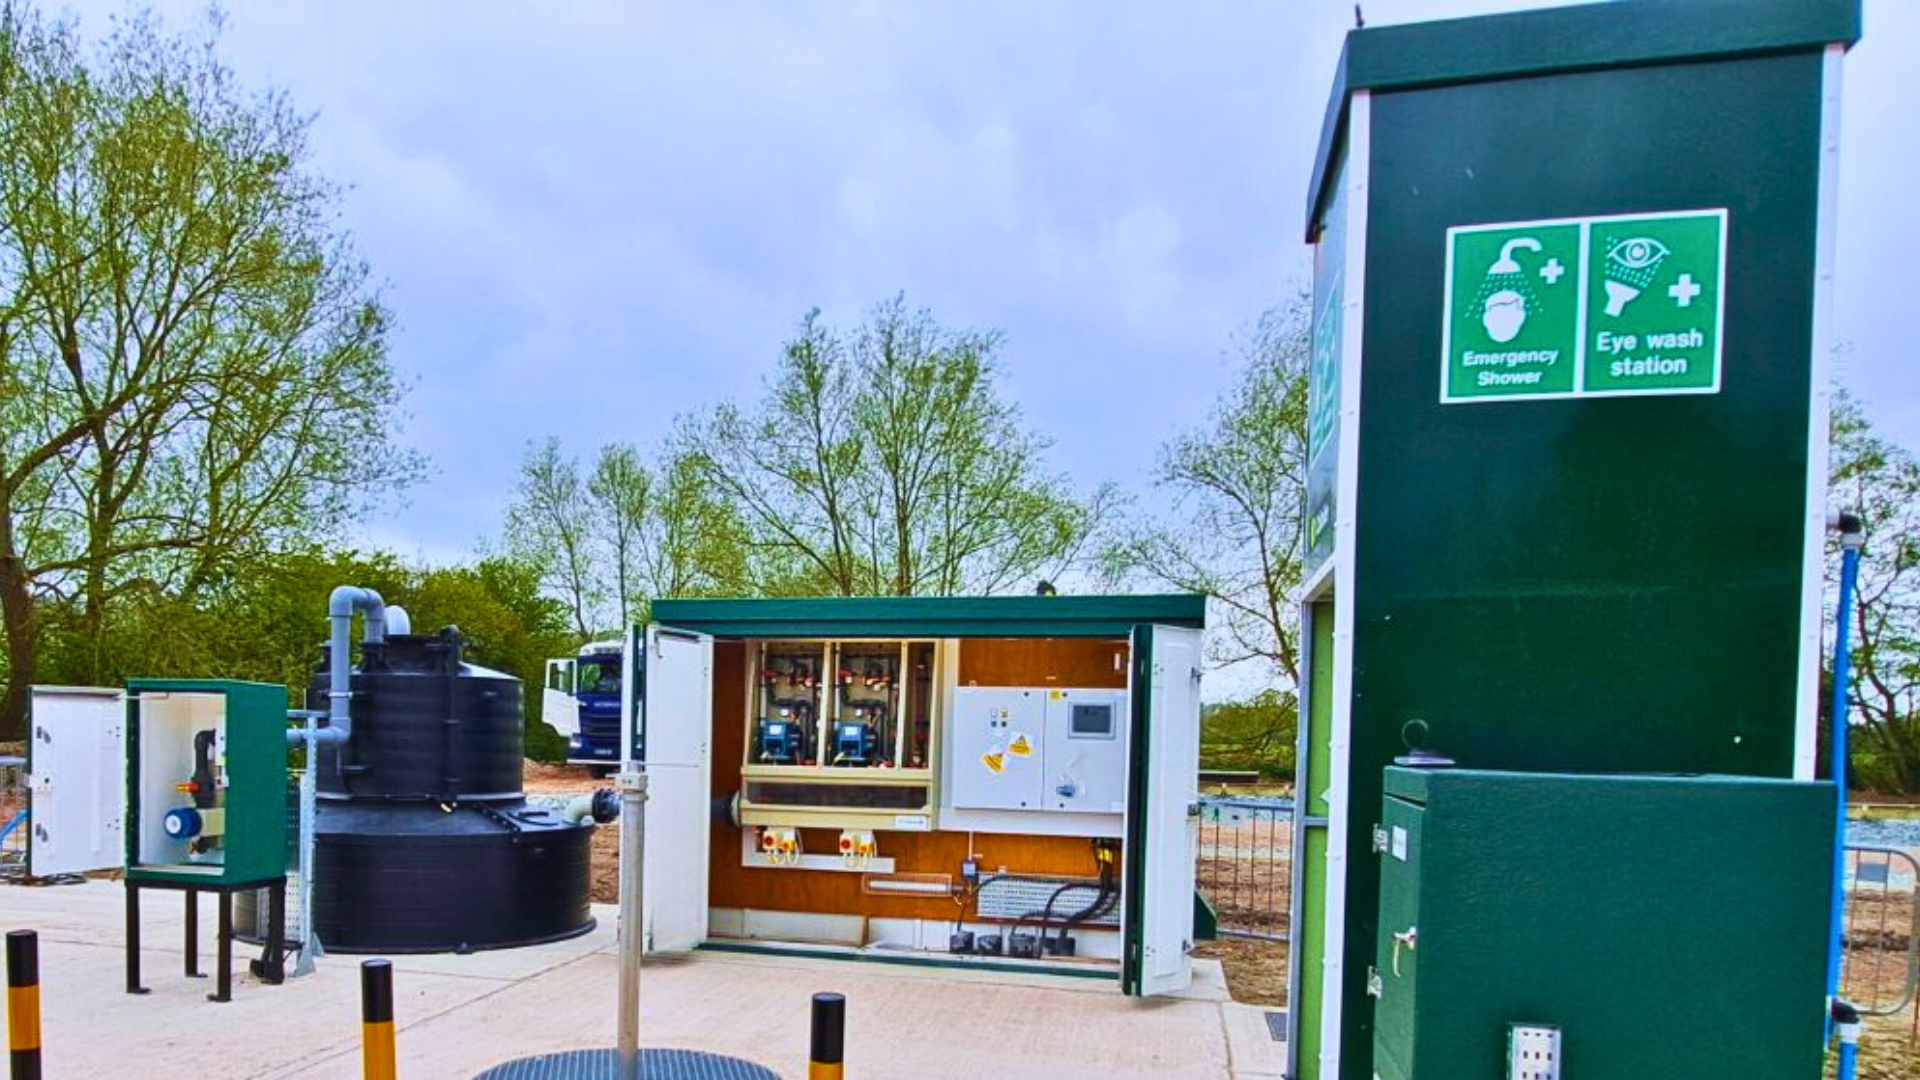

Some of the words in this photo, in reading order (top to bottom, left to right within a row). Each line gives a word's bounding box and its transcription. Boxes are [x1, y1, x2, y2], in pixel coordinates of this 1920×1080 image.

[1596, 331, 1636, 354] Eye
[1646, 328, 1703, 350] wash
[1462, 348, 1559, 367] Emergency
[1610, 355, 1687, 376] station
[1477, 370, 1543, 387] Shower
